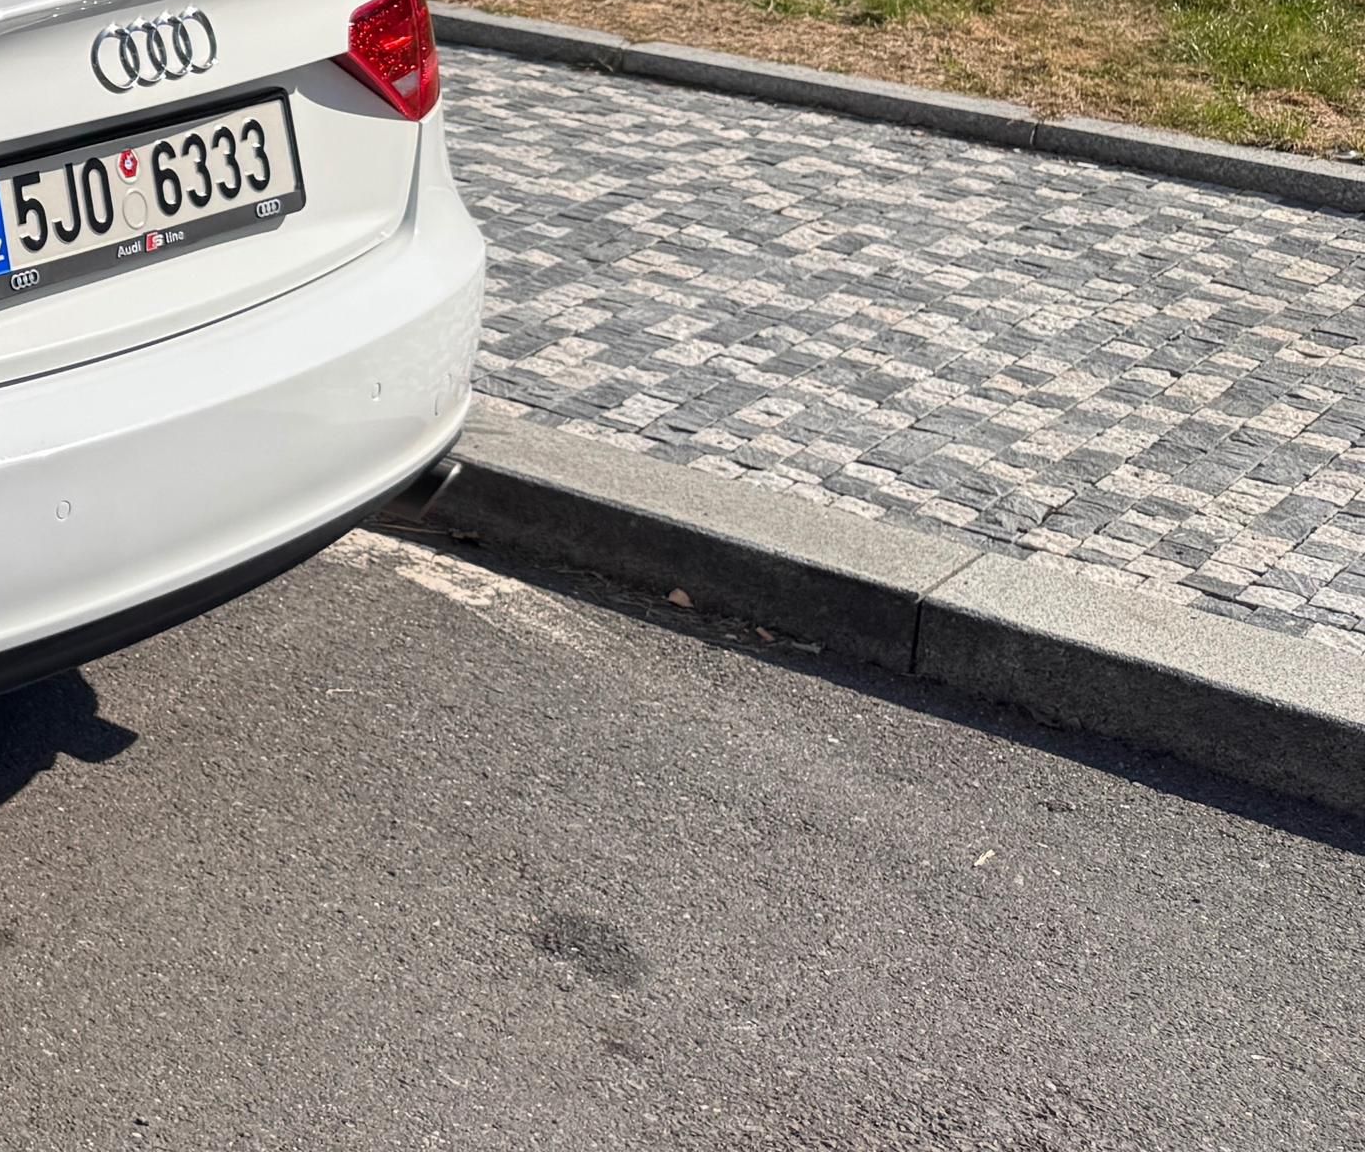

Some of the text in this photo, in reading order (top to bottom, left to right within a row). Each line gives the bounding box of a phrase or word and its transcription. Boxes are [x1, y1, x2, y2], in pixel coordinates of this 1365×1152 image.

[12, 115, 271, 252] 5J0 6333
[117, 240, 143, 259] Audi
[166, 228, 186, 244] line
